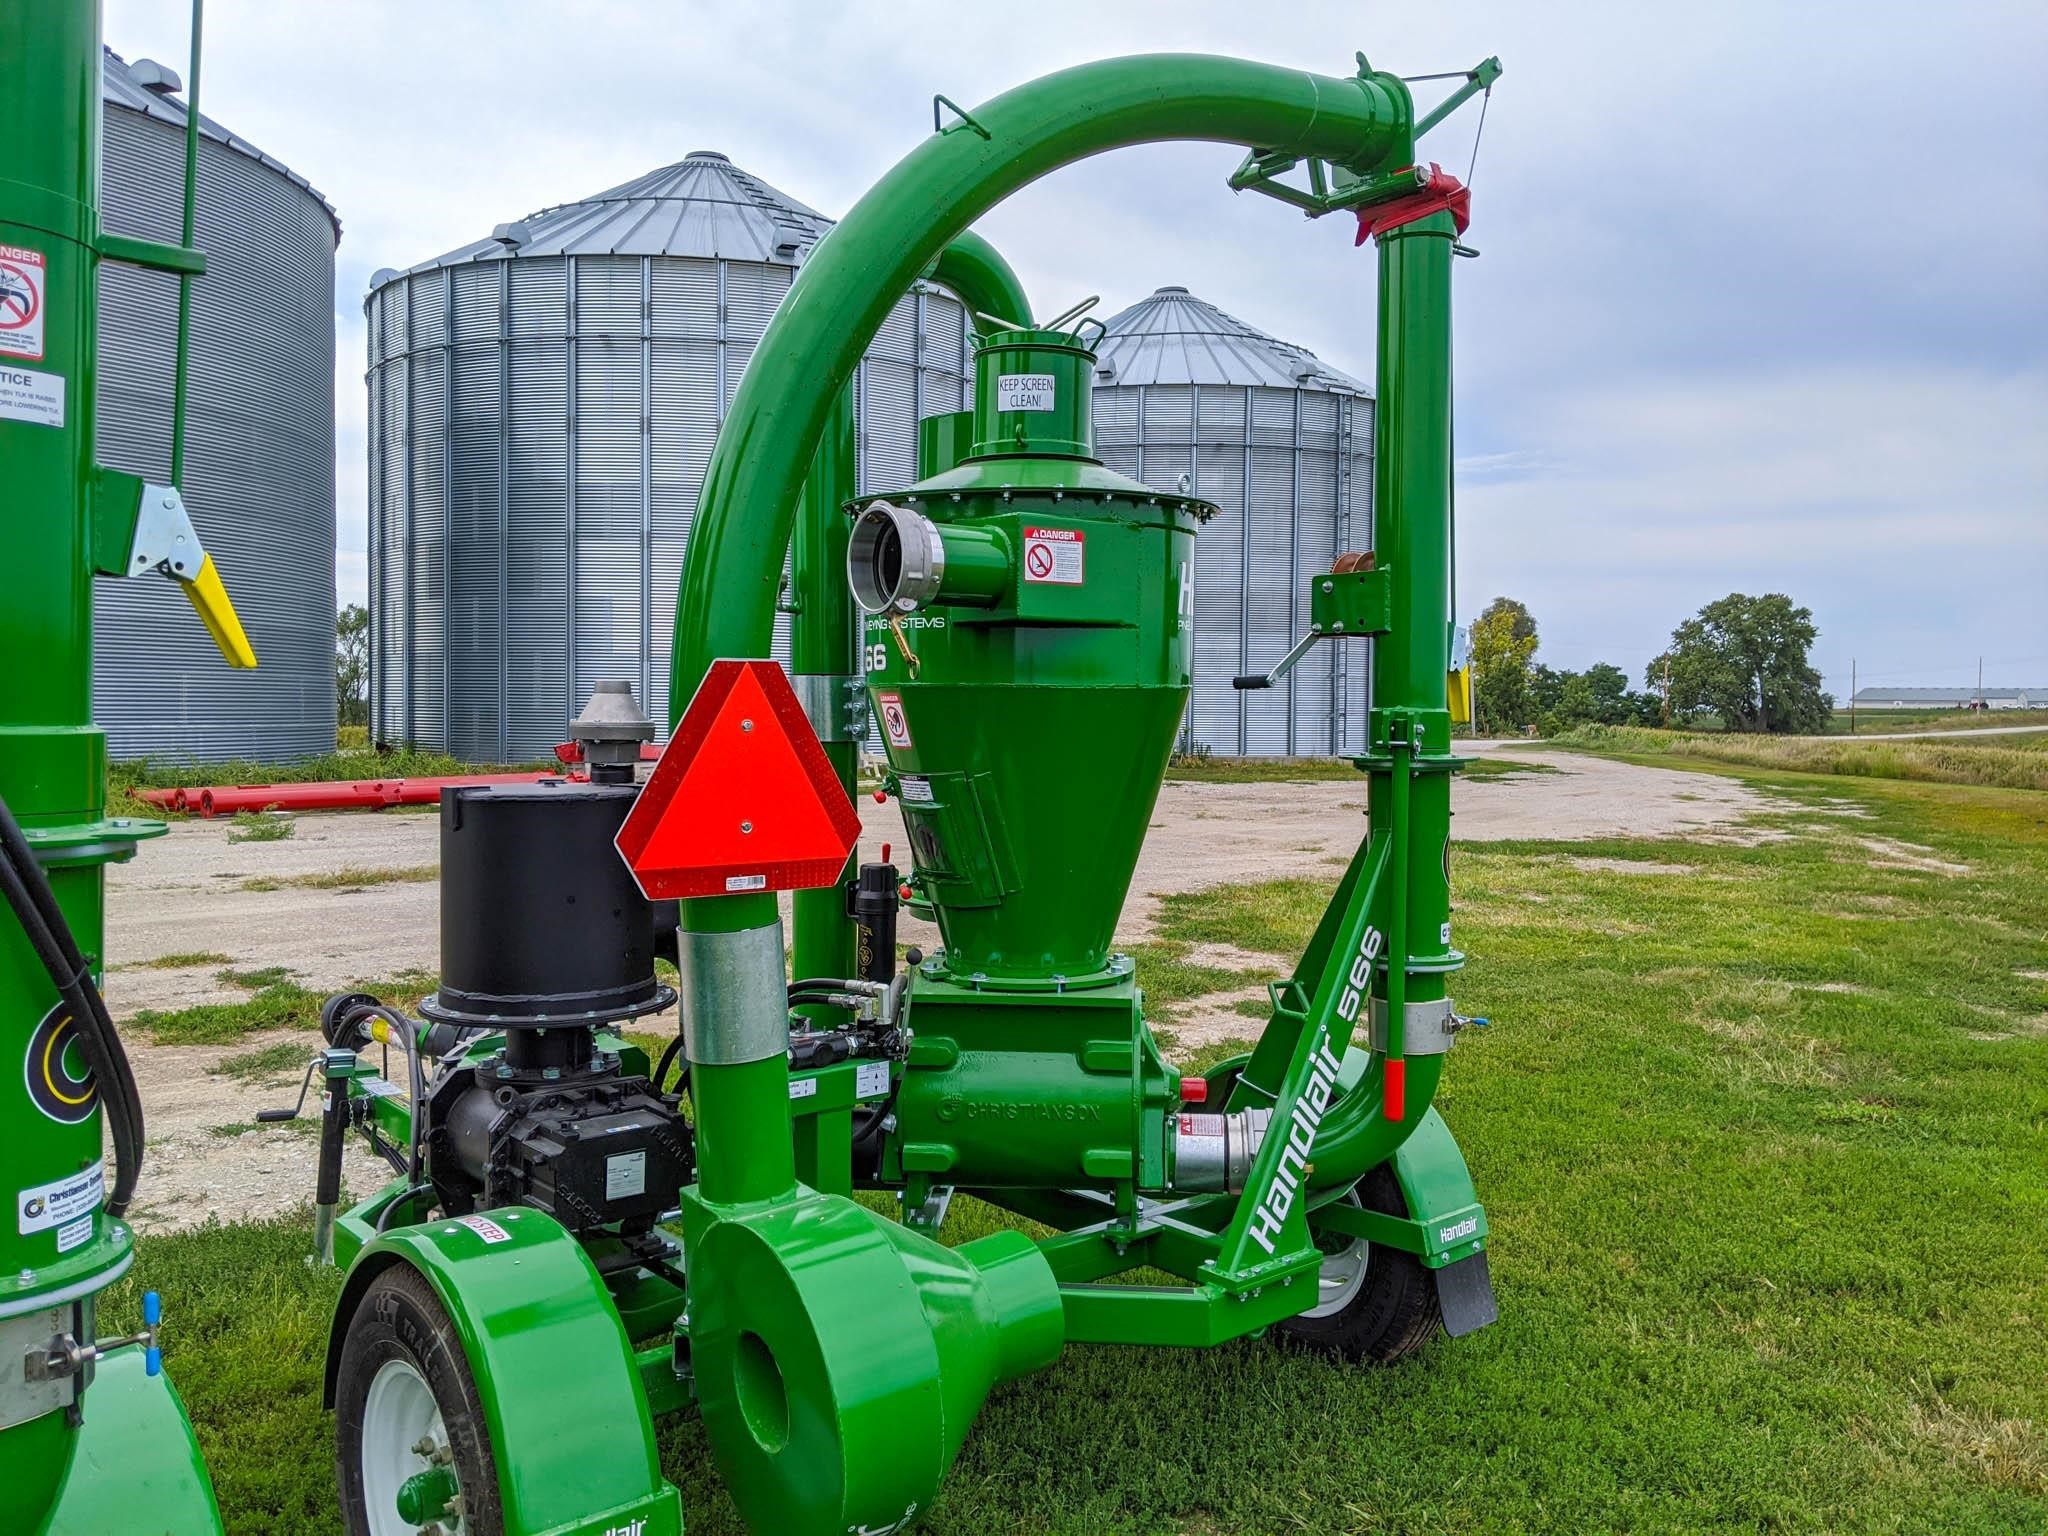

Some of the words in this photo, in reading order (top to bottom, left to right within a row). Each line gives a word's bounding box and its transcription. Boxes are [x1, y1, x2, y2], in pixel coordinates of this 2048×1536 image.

[999, 378, 1019, 391] KEEP
[1021, 377, 1053, 392] SCREEN
[1010, 394, 1042, 408] CLEAN!
[1040, 529, 1075, 541] DANGER
[1336, 925, 1383, 1022] 566
[967, 1101, 1101, 1121] CHRISTIANSON
[1248, 1033, 1341, 1254] Handlair
[472, 1222, 505, 1240] STEP
[1440, 1216, 1478, 1244] Handlair
